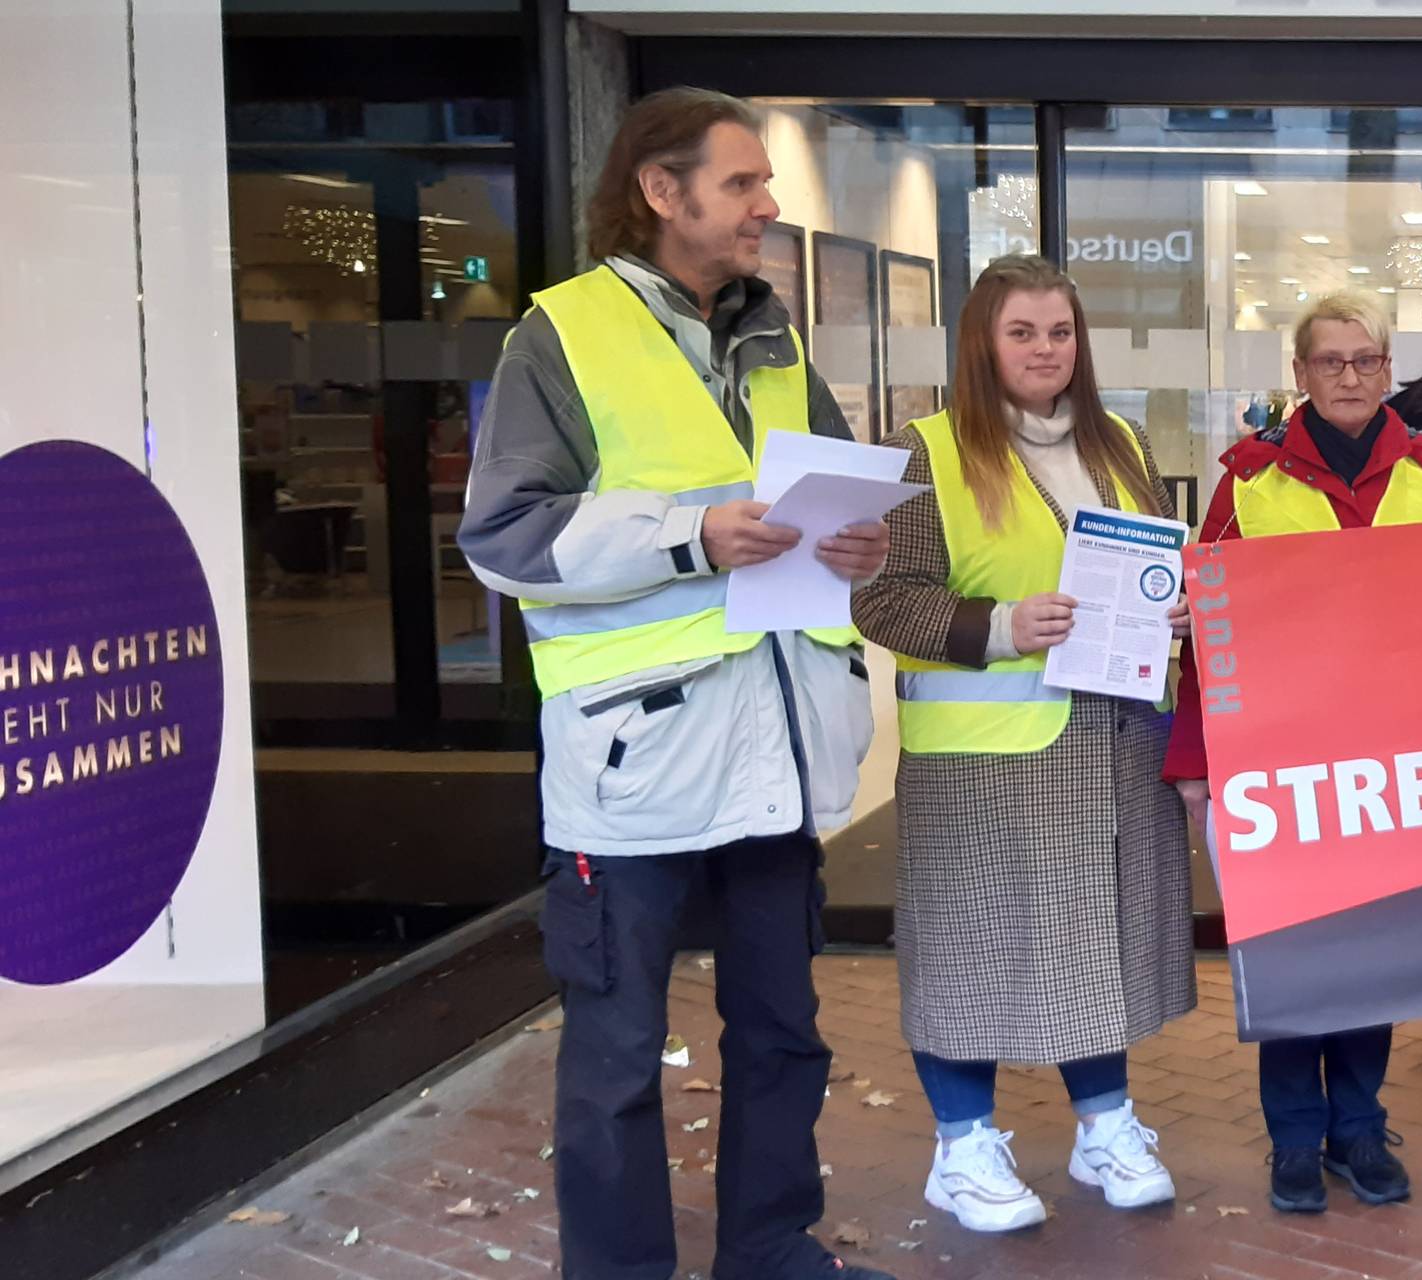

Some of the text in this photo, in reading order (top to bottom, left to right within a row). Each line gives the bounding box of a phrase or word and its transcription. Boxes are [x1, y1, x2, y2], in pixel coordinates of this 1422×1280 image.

[1081, 519, 1176, 545] KUNDEN-INFORMATION
[1195, 543, 1243, 714] Heute:
[4, 680, 163, 745] EHT NUR
